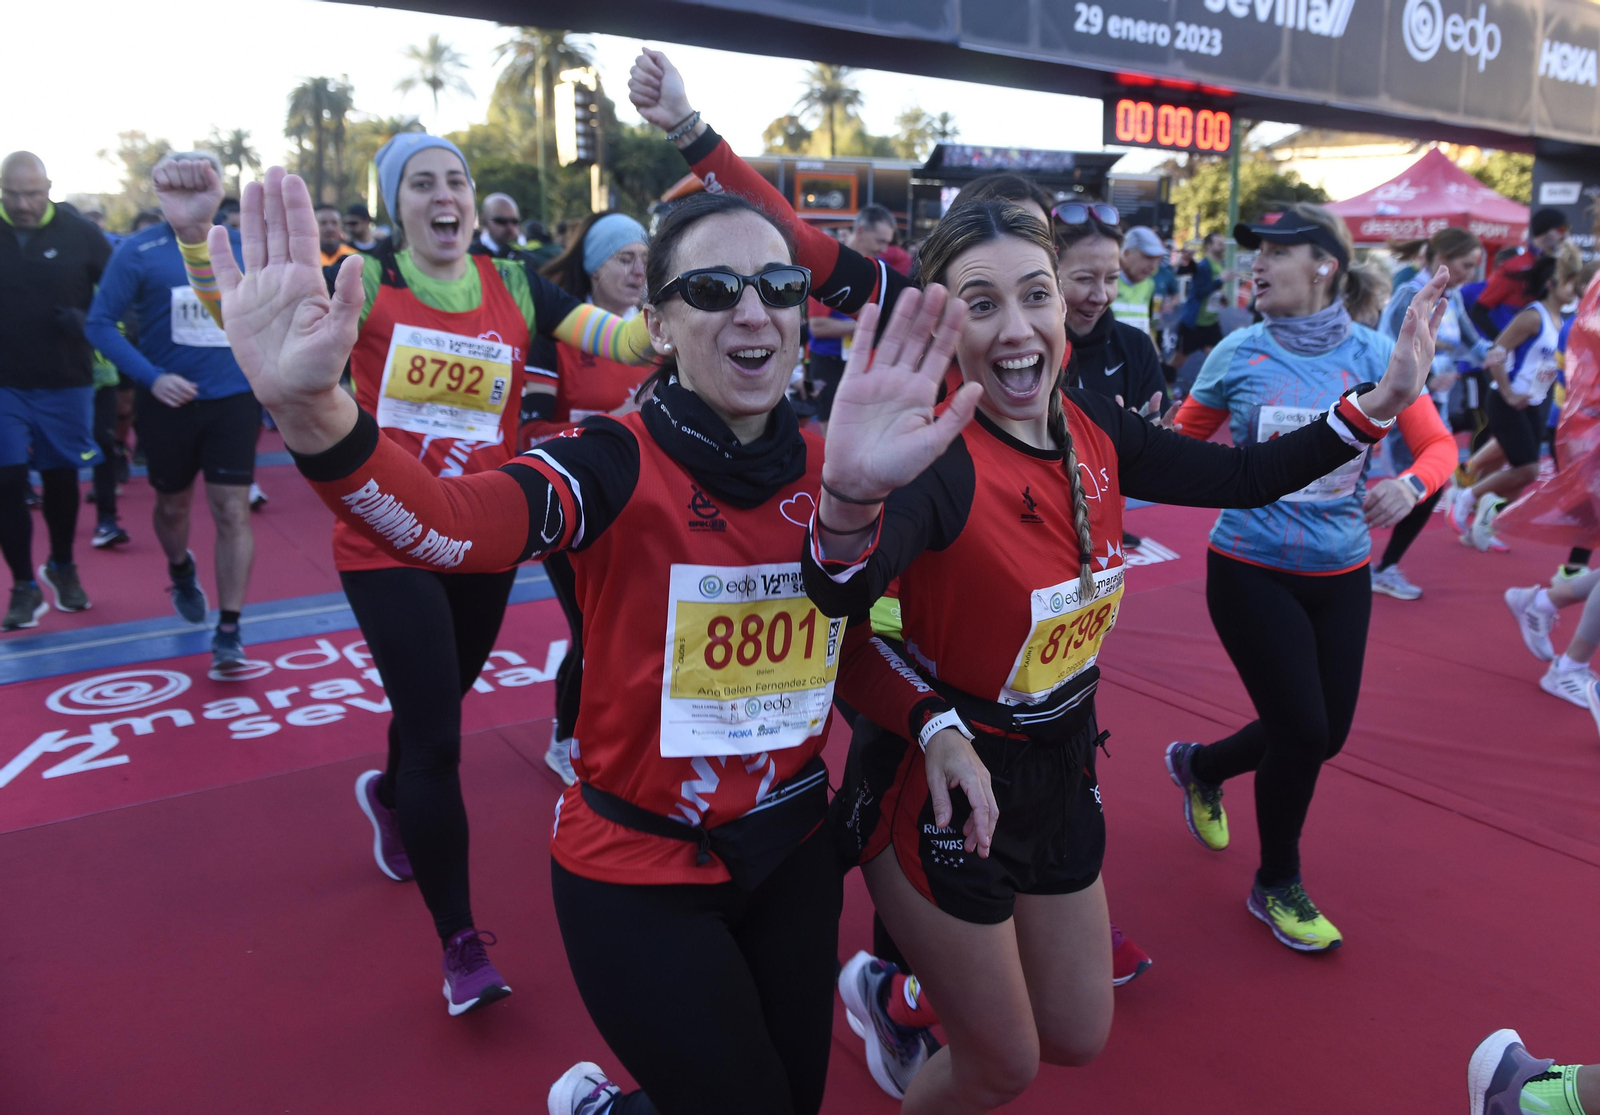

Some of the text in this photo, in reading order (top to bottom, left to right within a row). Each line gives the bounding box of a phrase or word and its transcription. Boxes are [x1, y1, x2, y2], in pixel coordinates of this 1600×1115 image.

[1074, 2, 1223, 56] 29 enero 2023
[1442, 3, 1502, 73] edp
[1538, 38, 1598, 87] HOKA
[407, 355, 484, 395] 8792
[341, 477, 473, 569] RUNNING RIVAS
[726, 573, 757, 597] edp
[704, 608, 816, 671] 8801
[1040, 603, 1111, 665] 8798
[755, 678, 807, 692] Fernandez
[763, 693, 791, 713] edp
[728, 729, 753, 739] HOKA
